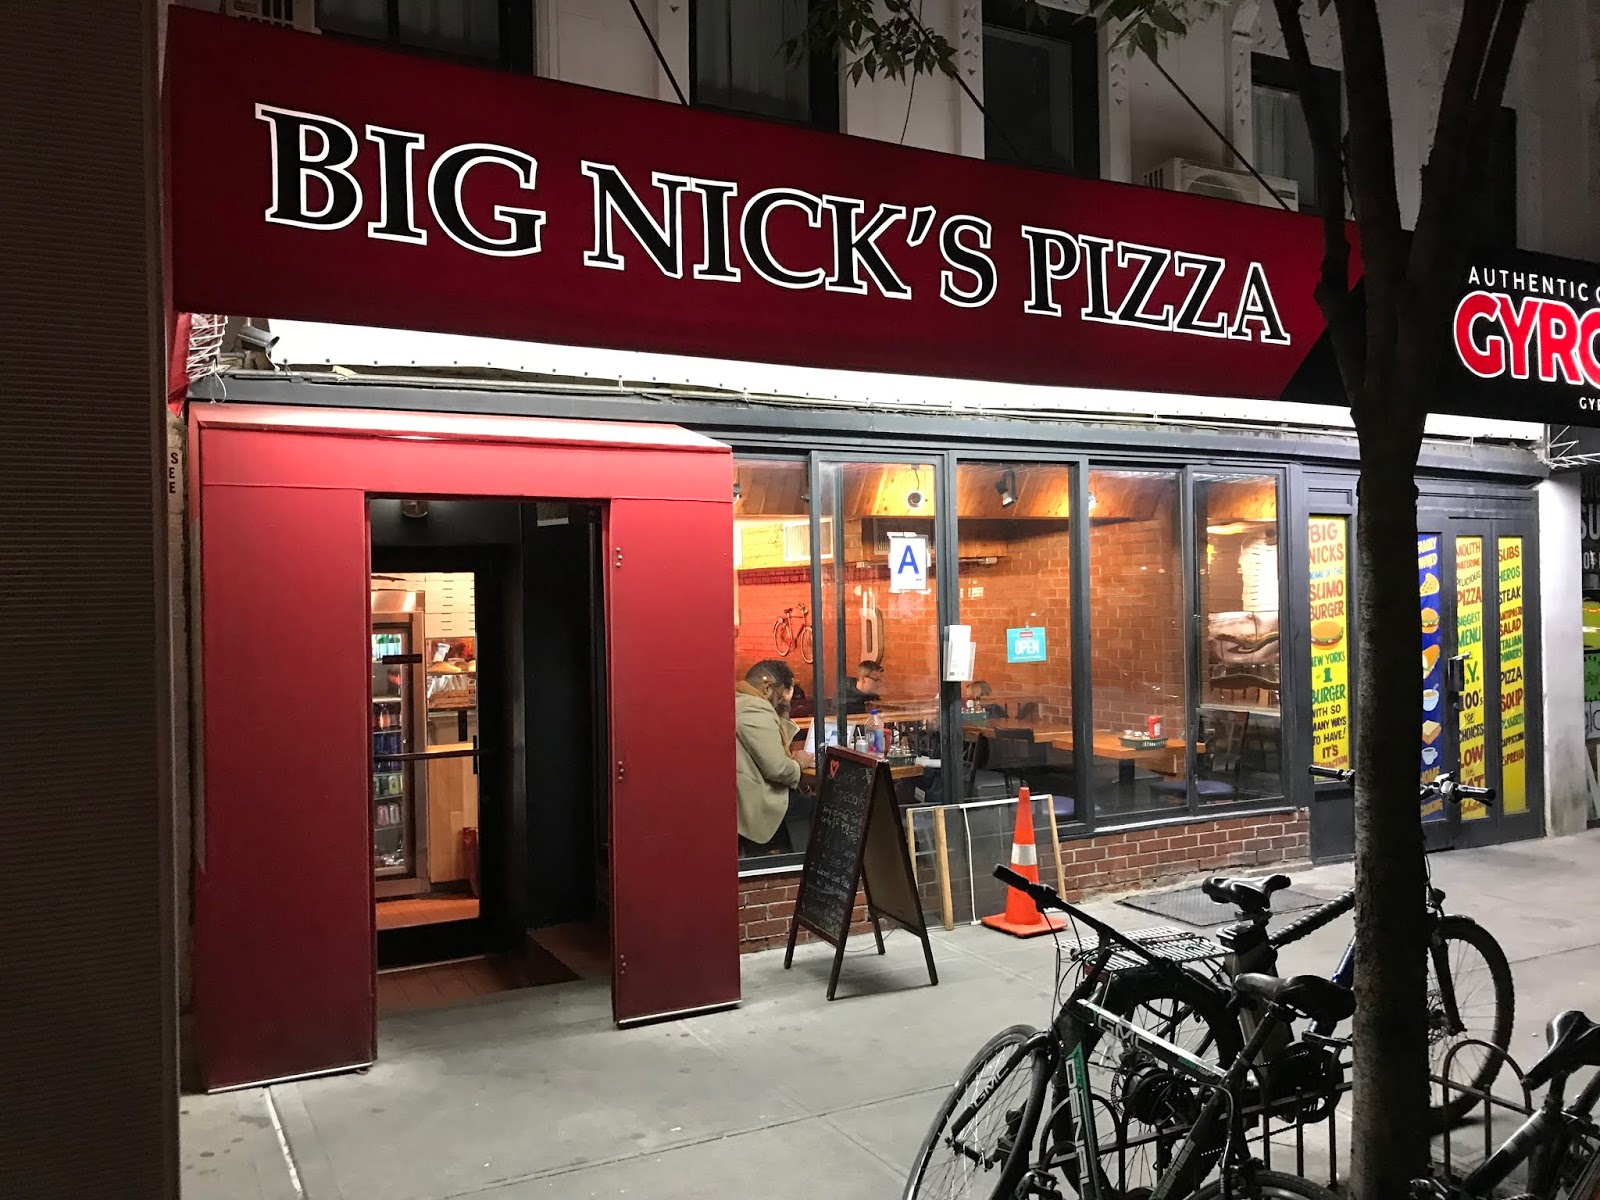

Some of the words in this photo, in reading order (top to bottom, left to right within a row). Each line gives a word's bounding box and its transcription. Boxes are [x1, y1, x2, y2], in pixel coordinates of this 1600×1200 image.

[254, 101, 547, 257] BIG
[580, 158, 998, 309] NICK'S
[1021, 224, 1292, 347] PIZZA
[1468, 266, 1589, 302] AUTHENTIC
[168, 452, 179, 494] SEE
[1309, 522, 1338, 543] BIG
[897, 545, 919, 574] A
[1309, 543, 1344, 565] NICKS
[1499, 545, 1520, 562] SUBS
[1499, 565, 1521, 583] HEROS
[1310, 579, 1344, 602] SUMO
[1457, 586, 1482, 607] PIZZA
[1499, 585, 1522, 605] STEAK
[1310, 600, 1345, 622] BURGER
[1499, 617, 1522, 637] SALAD
[1014, 639, 1040, 656] OPEN
[1500, 634, 1522, 650] TALIAN
[1323, 667, 1333, 683] 1
[1500, 665, 1522, 685] PIZZA
[1311, 683, 1346, 705] BURGER
[1501, 687, 1523, 712] SOUP
[1331, 704, 1341, 715] SO
[1331, 715, 1347, 728] WAYS
[1322, 744, 1339, 759] IT'S
[1097, 1014, 1153, 1053] GMC
[973, 1067, 1010, 1108] GMC
